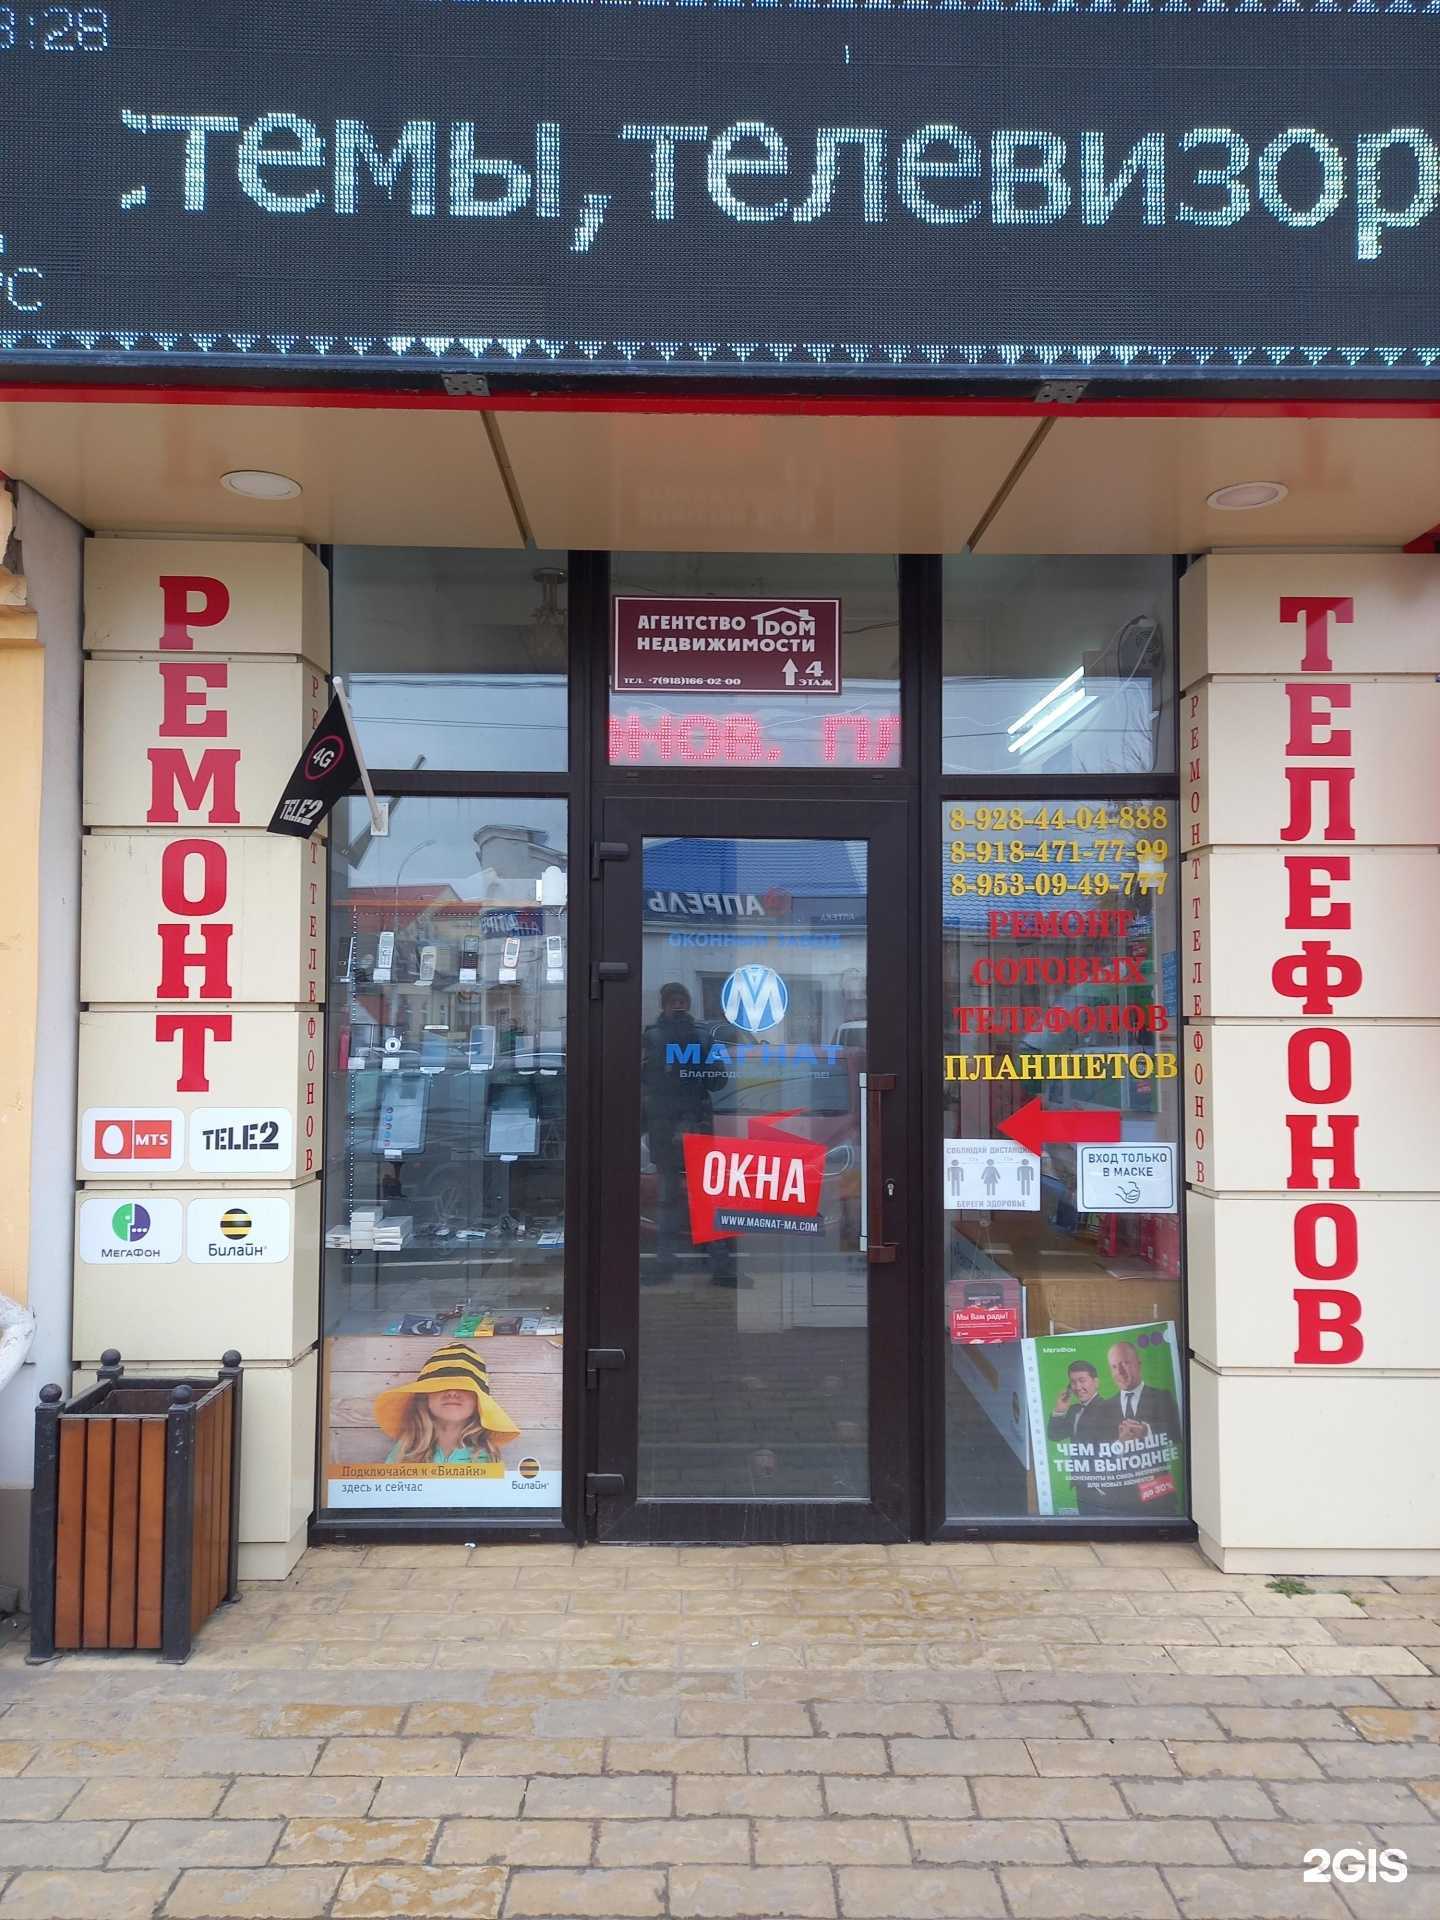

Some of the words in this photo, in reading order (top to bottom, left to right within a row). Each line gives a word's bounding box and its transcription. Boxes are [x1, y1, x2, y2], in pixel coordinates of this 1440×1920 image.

[121, 110, 612, 253] темы,
[618, 121, 1440, 260] телевизор
[637, 614, 746, 631] АГЕНТСТВО
[636, 636, 816, 653] НЕДВИЖИМОСТИ
[805, 660, 824, 677] 4
[798, 678, 833, 687] ЭТАЖ
[313, 747, 335, 769] 4G
[1189, 694, 1202, 881] РЕМОНТ
[280, 799, 324, 826] TELE2
[950, 806, 1169, 831] 8-928-44-04-888
[146, 575, 241, 1092] РЕМОНТ
[951, 839, 1169, 864] 8-918-471-77-99
[951, 872, 1169, 897] 8-953-09-49-777
[986, 909, 1137, 939] РЕМОНТ
[971, 956, 1149, 986] СОТОВЫХ
[1271, 596, 1365, 1365] ТЕЛЕФОНОВ
[953, 1005, 1170, 1035] ТЕЛЕФОНОВ
[1191, 896, 1206, 1184] ТЕЛЕФОНОВ
[664, 1043, 845, 1066] МАГНАТ
[944, 1053, 1178, 1081] ПЛАНШЕТОВ
[135, 1133, 169, 1146] MTS
[202, 1120, 280, 1150] TELE2
[1088, 1153, 1119, 1164] ВХОД
[1121, 1153, 1168, 1163] ТОЛЬКО
[702, 1150, 806, 1203] ОКНА
[1103, 1167, 1110, 1177] В
[1114, 1167, 1154, 1177] МАСКЕ
[721, 1215, 818, 1232] WWW.MAGNAT-MA.COM
[1056, 1442, 1095, 1457] ЧЕМ
[1099, 1432, 1173, 1458] ДОЛЬШЕ,
[342, 1466, 418, 1478] Подключайся
[431, 1465, 487, 1477] «Билайн»
[1053, 1459, 1090, 1473] ТЕМ
[1094, 1446, 1180, 1473] ВЫГОДНЕЕ
[342, 1483, 372, 1493] здесь
[375, 1484, 382, 1492] и
[385, 1481, 423, 1492] сейчас
